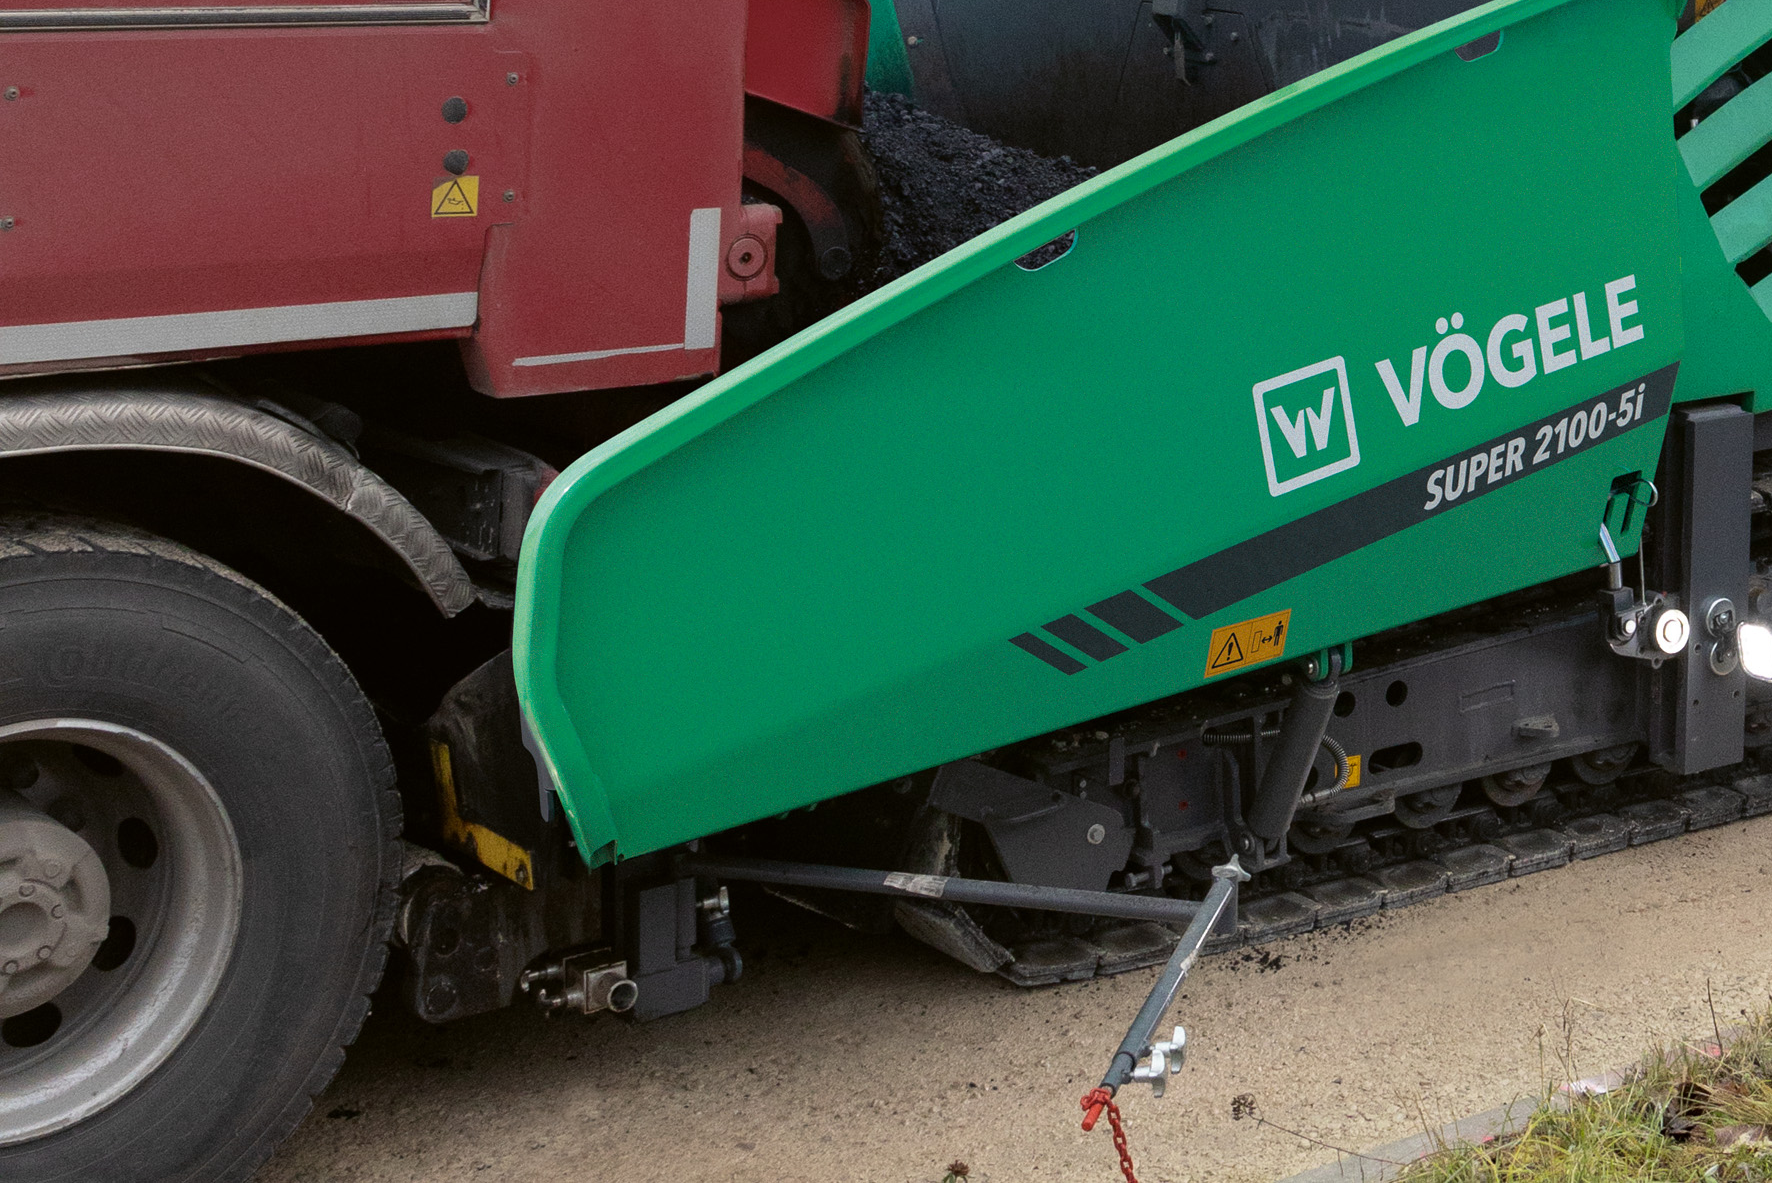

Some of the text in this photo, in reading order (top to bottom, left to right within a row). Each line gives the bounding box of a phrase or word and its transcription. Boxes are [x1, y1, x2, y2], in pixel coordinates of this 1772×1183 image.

[1374, 273, 1645, 427] VÖGELE
[1423, 382, 1647, 511] SUPER 2100-5i
